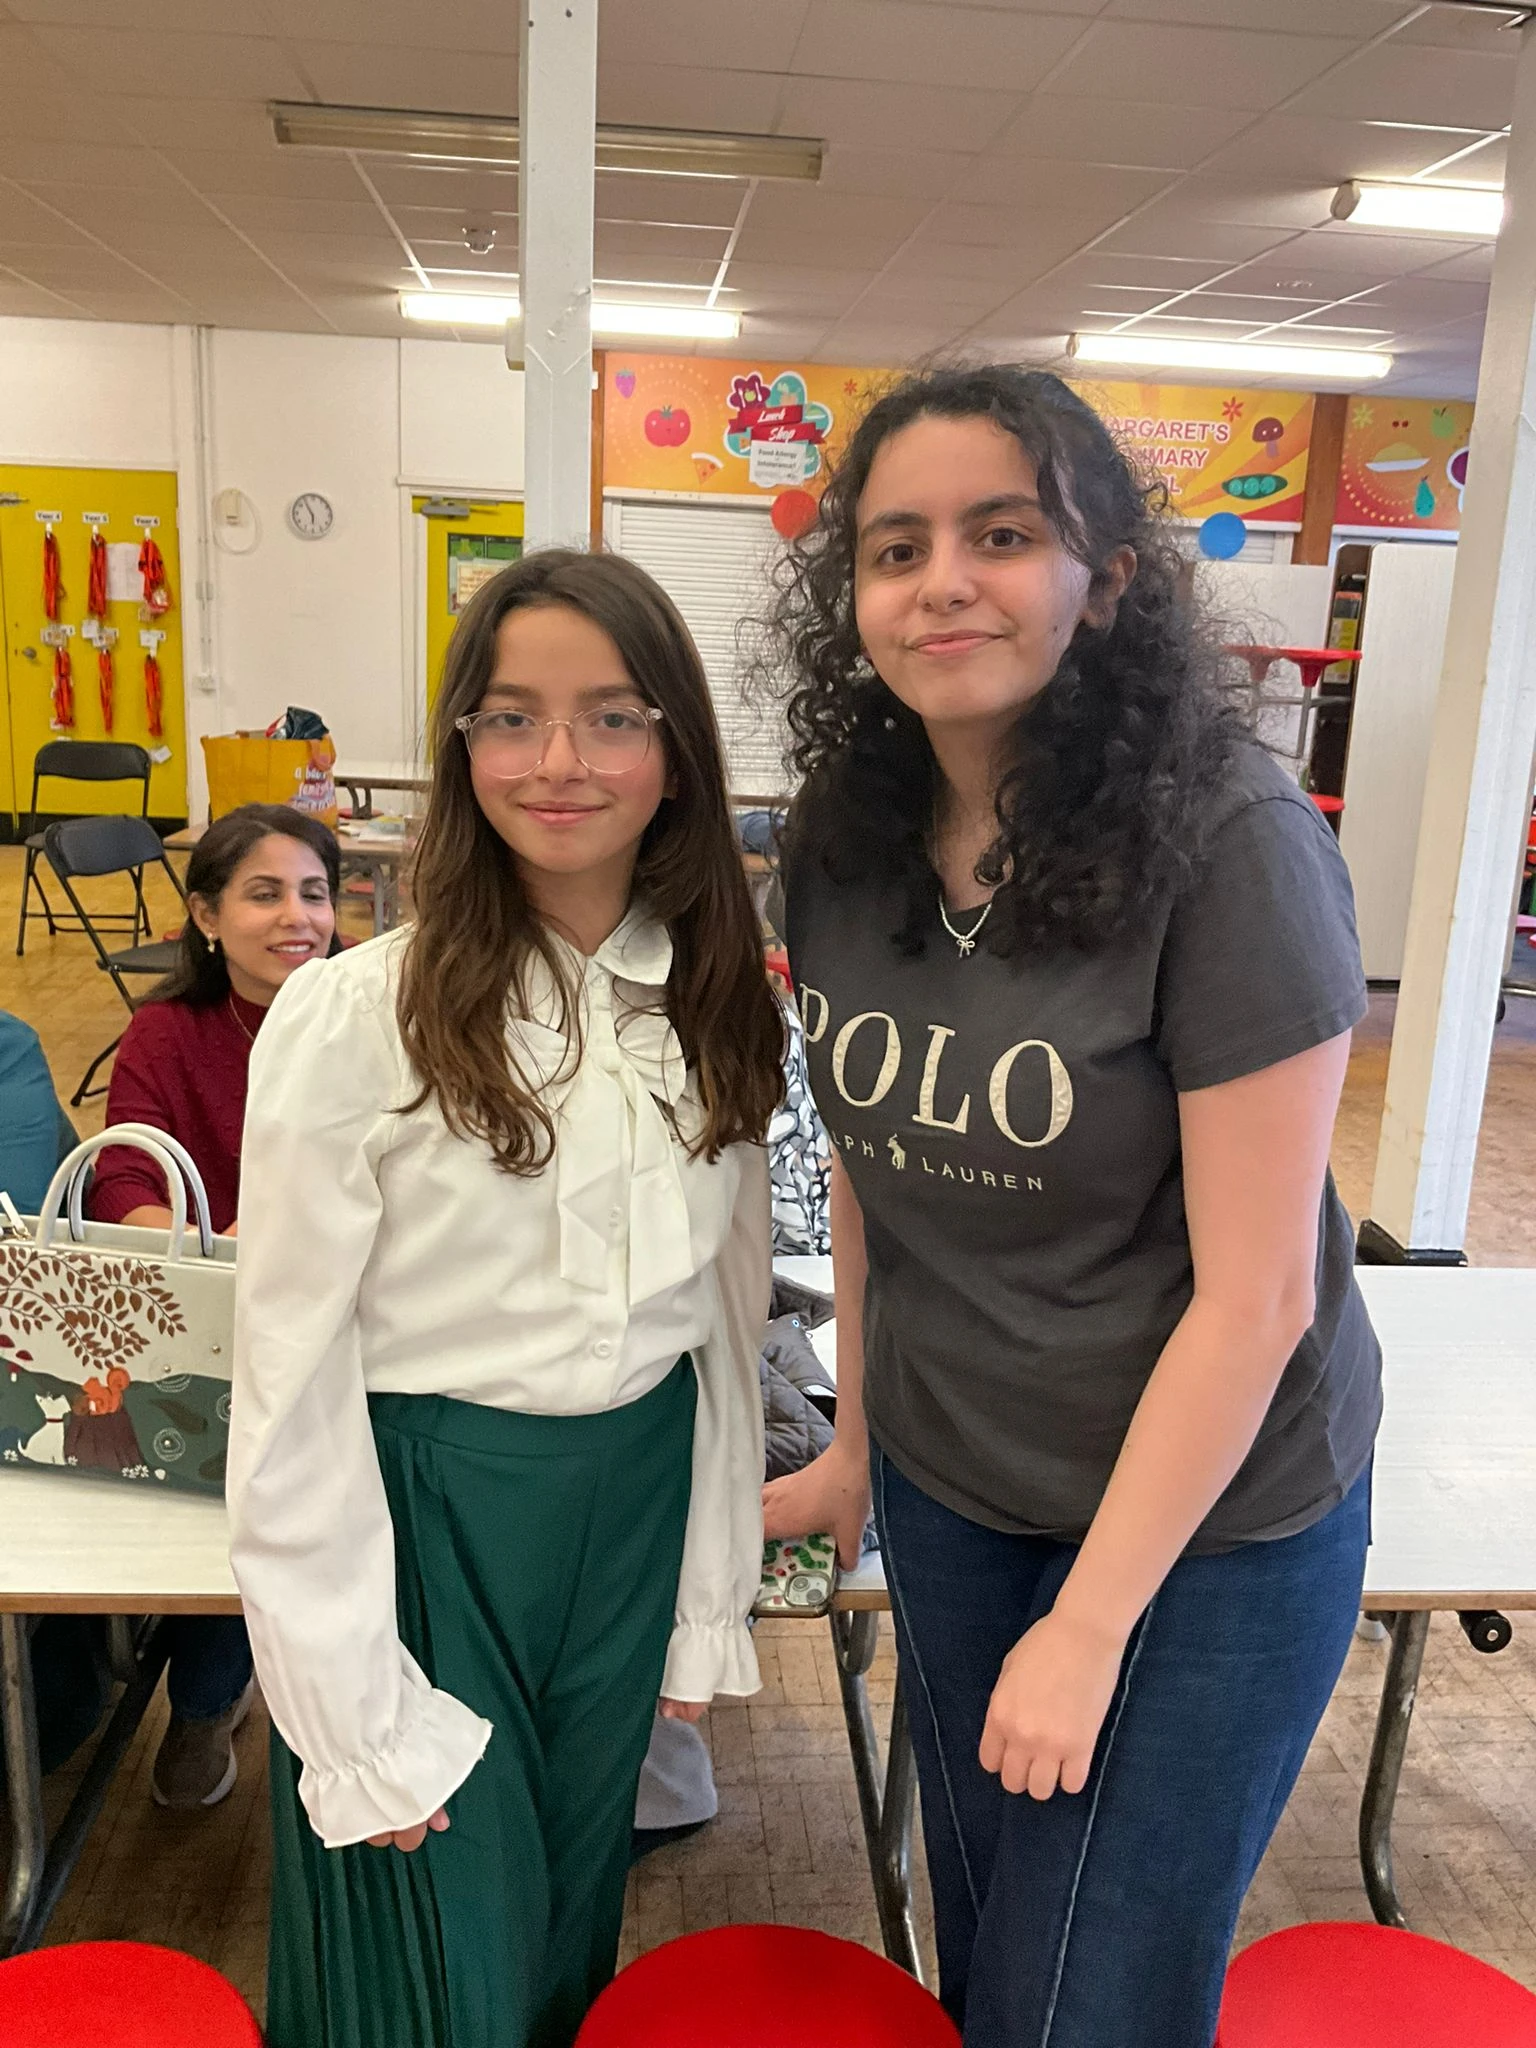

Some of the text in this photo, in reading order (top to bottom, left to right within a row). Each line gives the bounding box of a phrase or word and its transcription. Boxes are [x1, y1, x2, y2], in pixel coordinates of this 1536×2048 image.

[757, 408, 786, 423] Lunch
[768, 426, 796, 444] Shop
[800, 983, 1073, 1148] POLO
[832, 1130, 1043, 1191] LPH LAUREN
